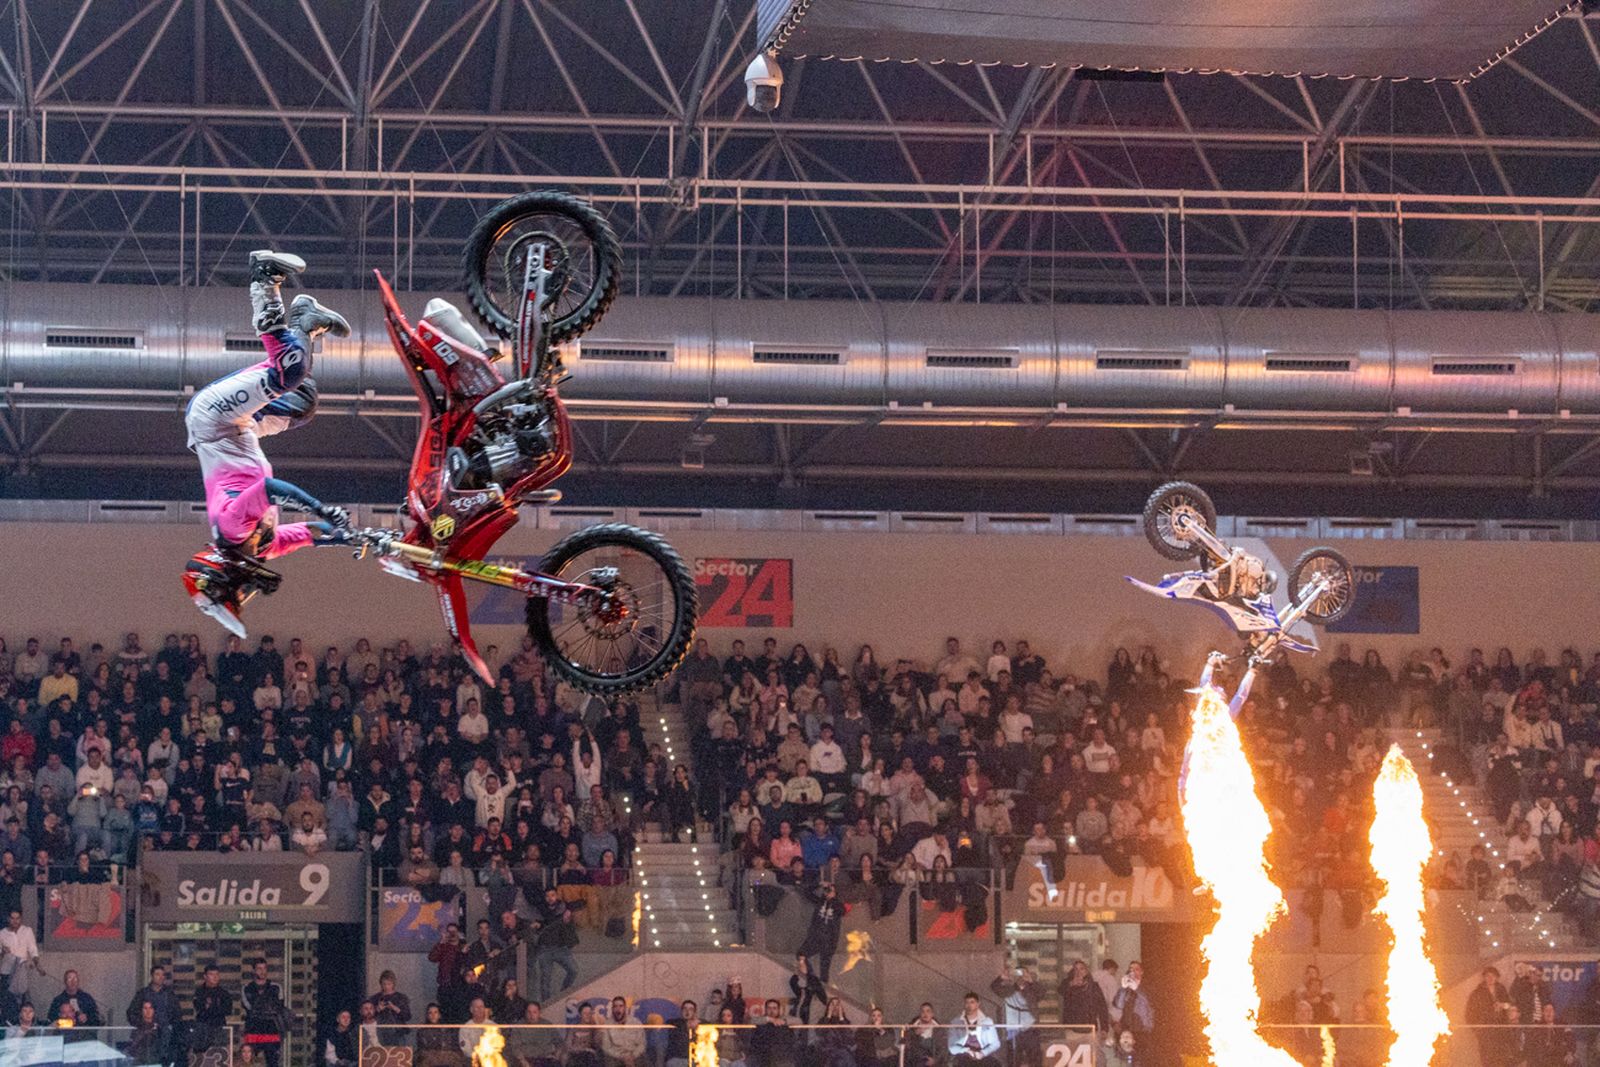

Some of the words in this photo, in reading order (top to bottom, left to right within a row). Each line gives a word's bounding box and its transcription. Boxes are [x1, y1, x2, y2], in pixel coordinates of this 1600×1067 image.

[695, 560, 758, 576] Sector
[695, 559, 793, 628] 24
[177, 879, 281, 906] Salida
[300, 863, 330, 906] 9
[1542, 964, 1584, 982] ctor
[1046, 1044, 1093, 1067] 24
